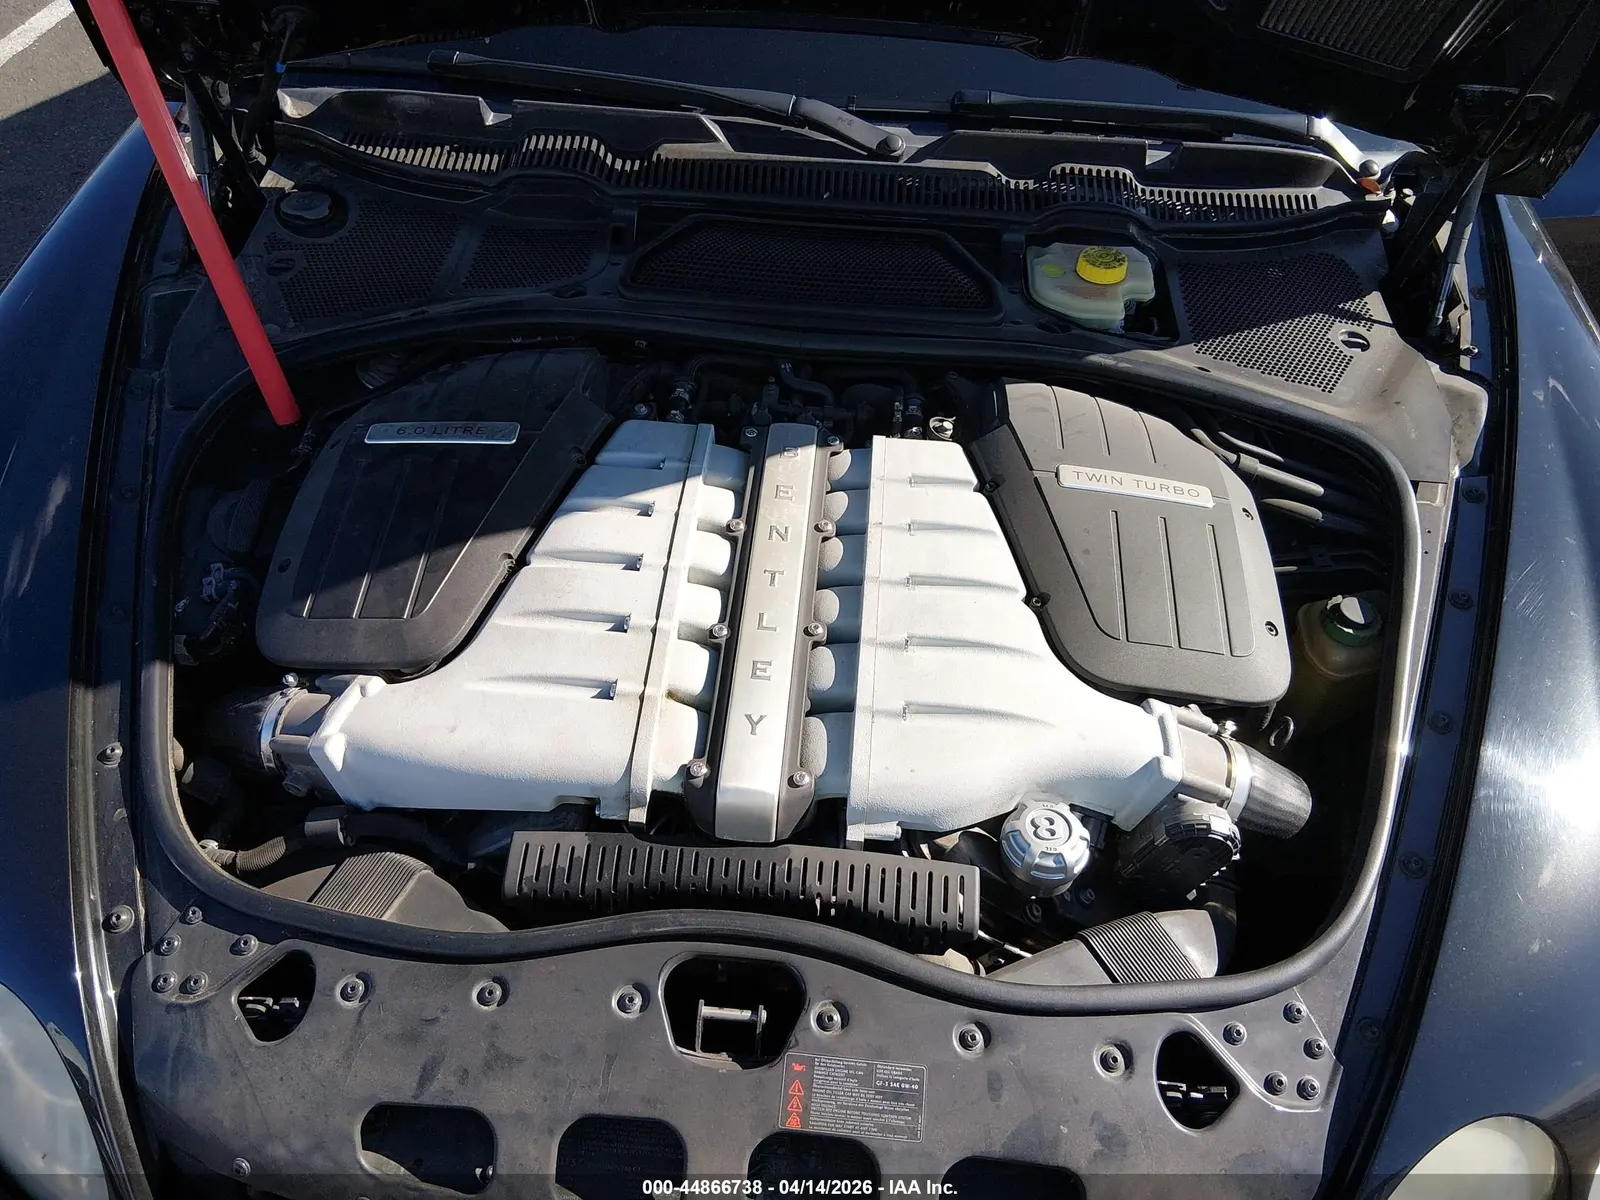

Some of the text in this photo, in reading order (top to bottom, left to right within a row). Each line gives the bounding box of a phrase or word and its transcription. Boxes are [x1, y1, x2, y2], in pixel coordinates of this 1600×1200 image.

[396, 426, 487, 436] 6.0 LITRE
[1072, 470, 1200, 498] TWIN TURBO
[744, 445, 799, 736] BENTLEY
